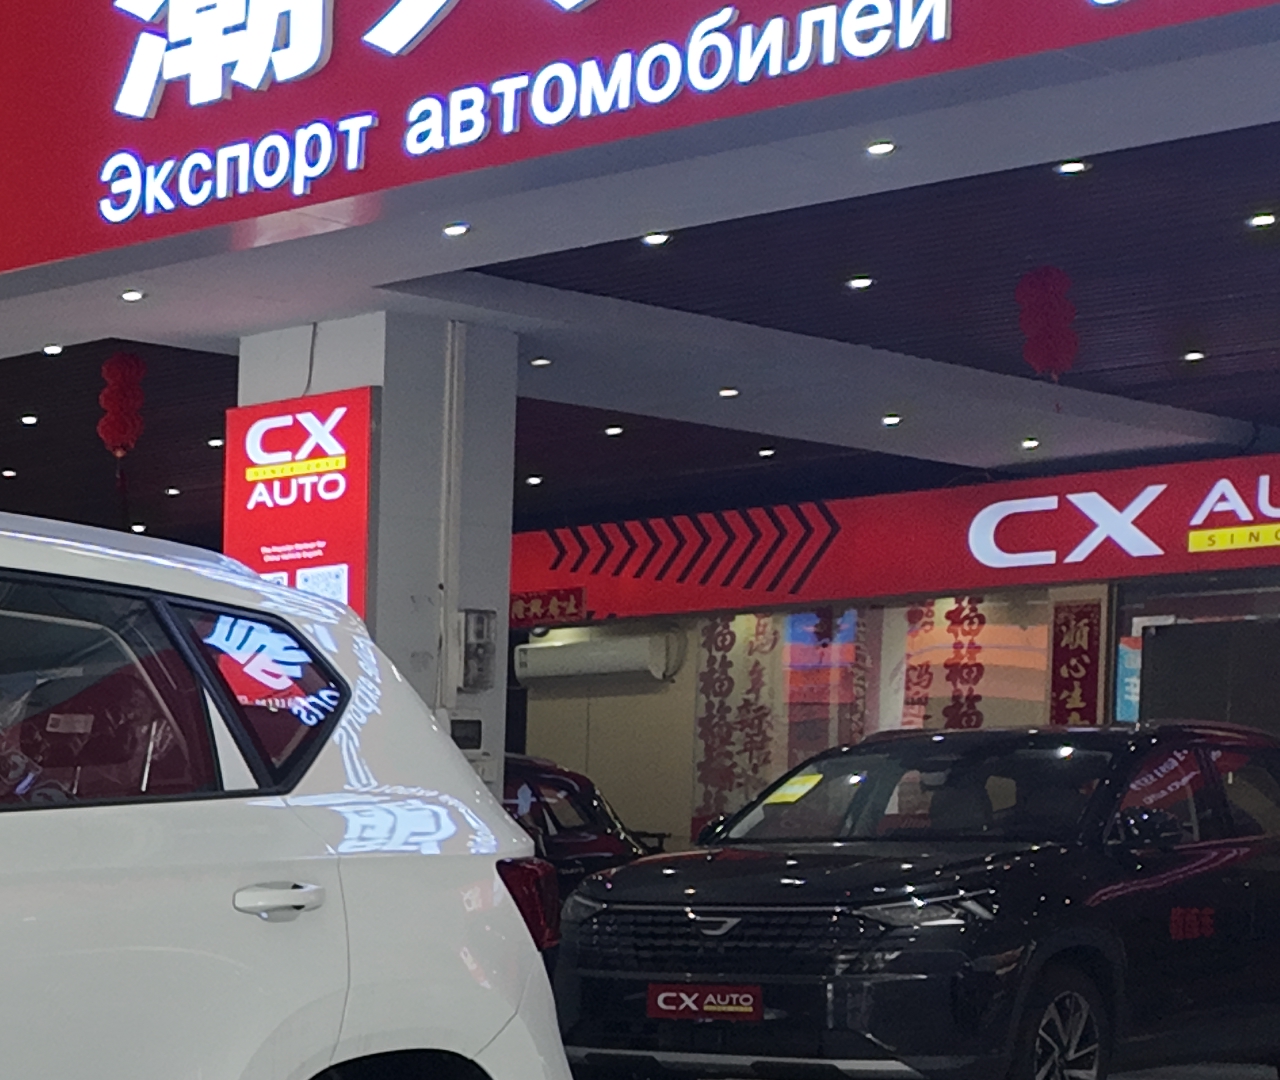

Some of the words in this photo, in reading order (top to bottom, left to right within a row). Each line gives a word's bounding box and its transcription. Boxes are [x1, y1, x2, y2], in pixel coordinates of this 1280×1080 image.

[99, 113, 373, 222] Экспорт
[245, 407, 348, 465] CX
[246, 472, 347, 510] AUTO
[968, 484, 1168, 568] CX
[657, 992, 700, 1011] CX
[703, 993, 754, 1006] AUTO
